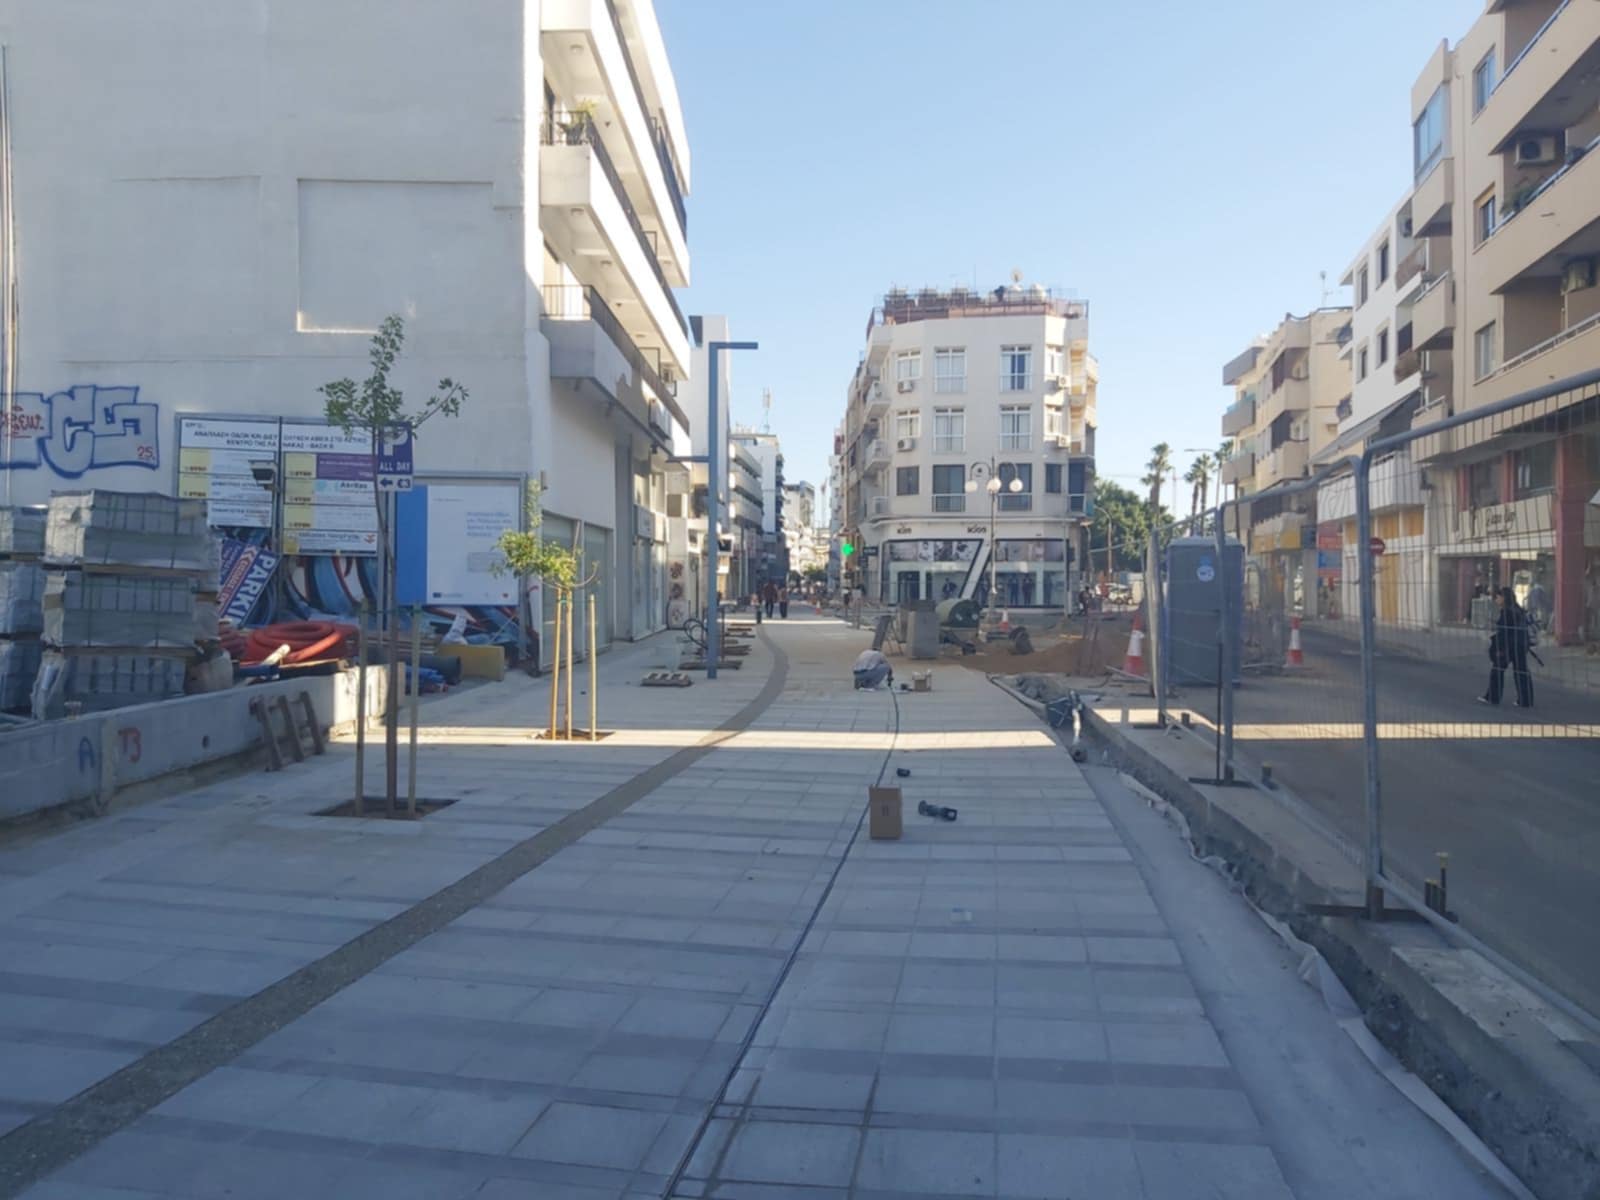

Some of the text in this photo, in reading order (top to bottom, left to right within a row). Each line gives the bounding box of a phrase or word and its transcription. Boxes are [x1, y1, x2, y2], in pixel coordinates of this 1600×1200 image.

[383, 426, 409, 456] P
[379, 461, 394, 472] ALL
[396, 461, 411, 472] DAY
